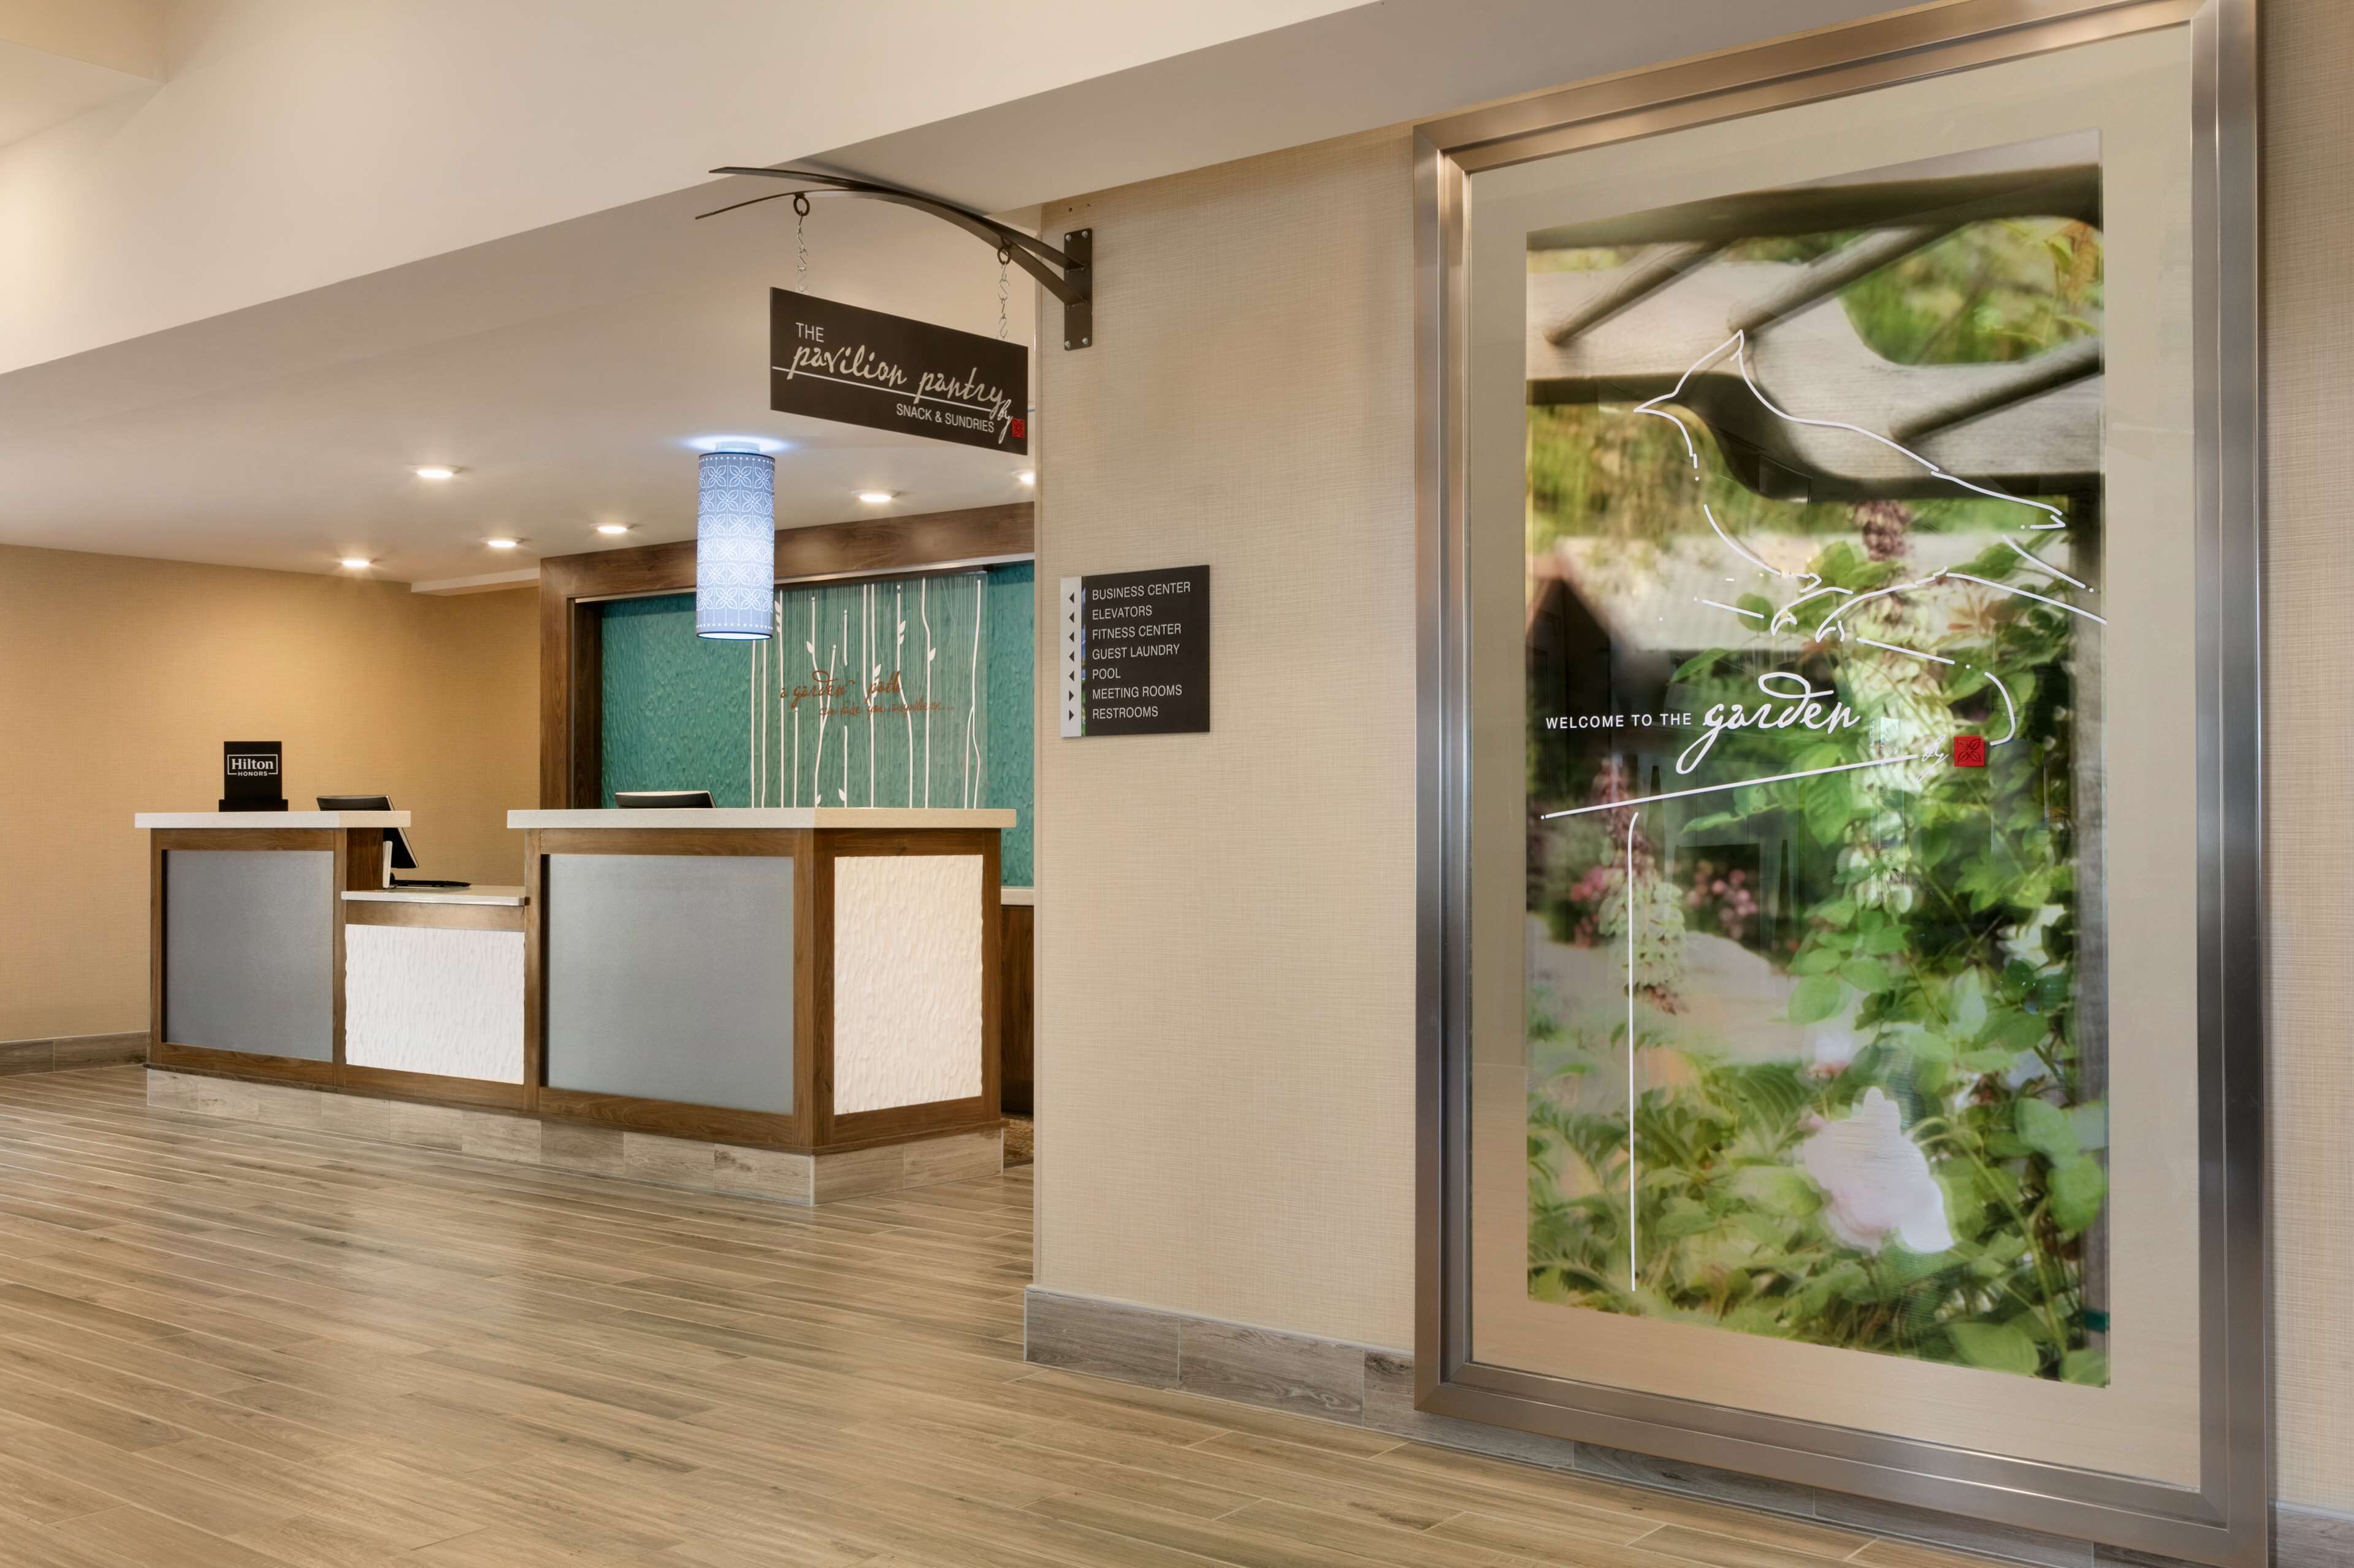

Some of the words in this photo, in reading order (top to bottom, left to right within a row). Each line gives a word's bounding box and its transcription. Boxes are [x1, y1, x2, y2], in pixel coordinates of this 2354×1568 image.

[795, 322, 824, 343] THE
[786, 345, 907, 387] pavilion
[913, 367, 1006, 420] pantry
[896, 403, 932, 421] SNACK
[934, 411, 942, 423] &
[945, 413, 995, 433] SUNDRIES
[1092, 585, 1145, 600] BUSINESS
[1147, 581, 1191, 596] CENTER
[1092, 605, 1153, 620] ELEVATORS
[1092, 626, 1136, 640] FITNESS
[1139, 623, 1182, 637] CENTER
[1092, 647, 1128, 660] GUEST
[1131, 644, 1180, 657] LAUNDRY
[1092, 668, 1121, 679] POOL
[1092, 687, 1139, 700] MEETING
[1142, 684, 1182, 697] ROOMS
[1092, 706, 1158, 719] RESTROOMS
[1546, 715, 1624, 729] WELCOME
[1631, 714, 1653, 727] TO
[1660, 713, 1692, 725] THE
[1676, 672, 1860, 774] garden
[232, 759, 274, 770] Hilton
